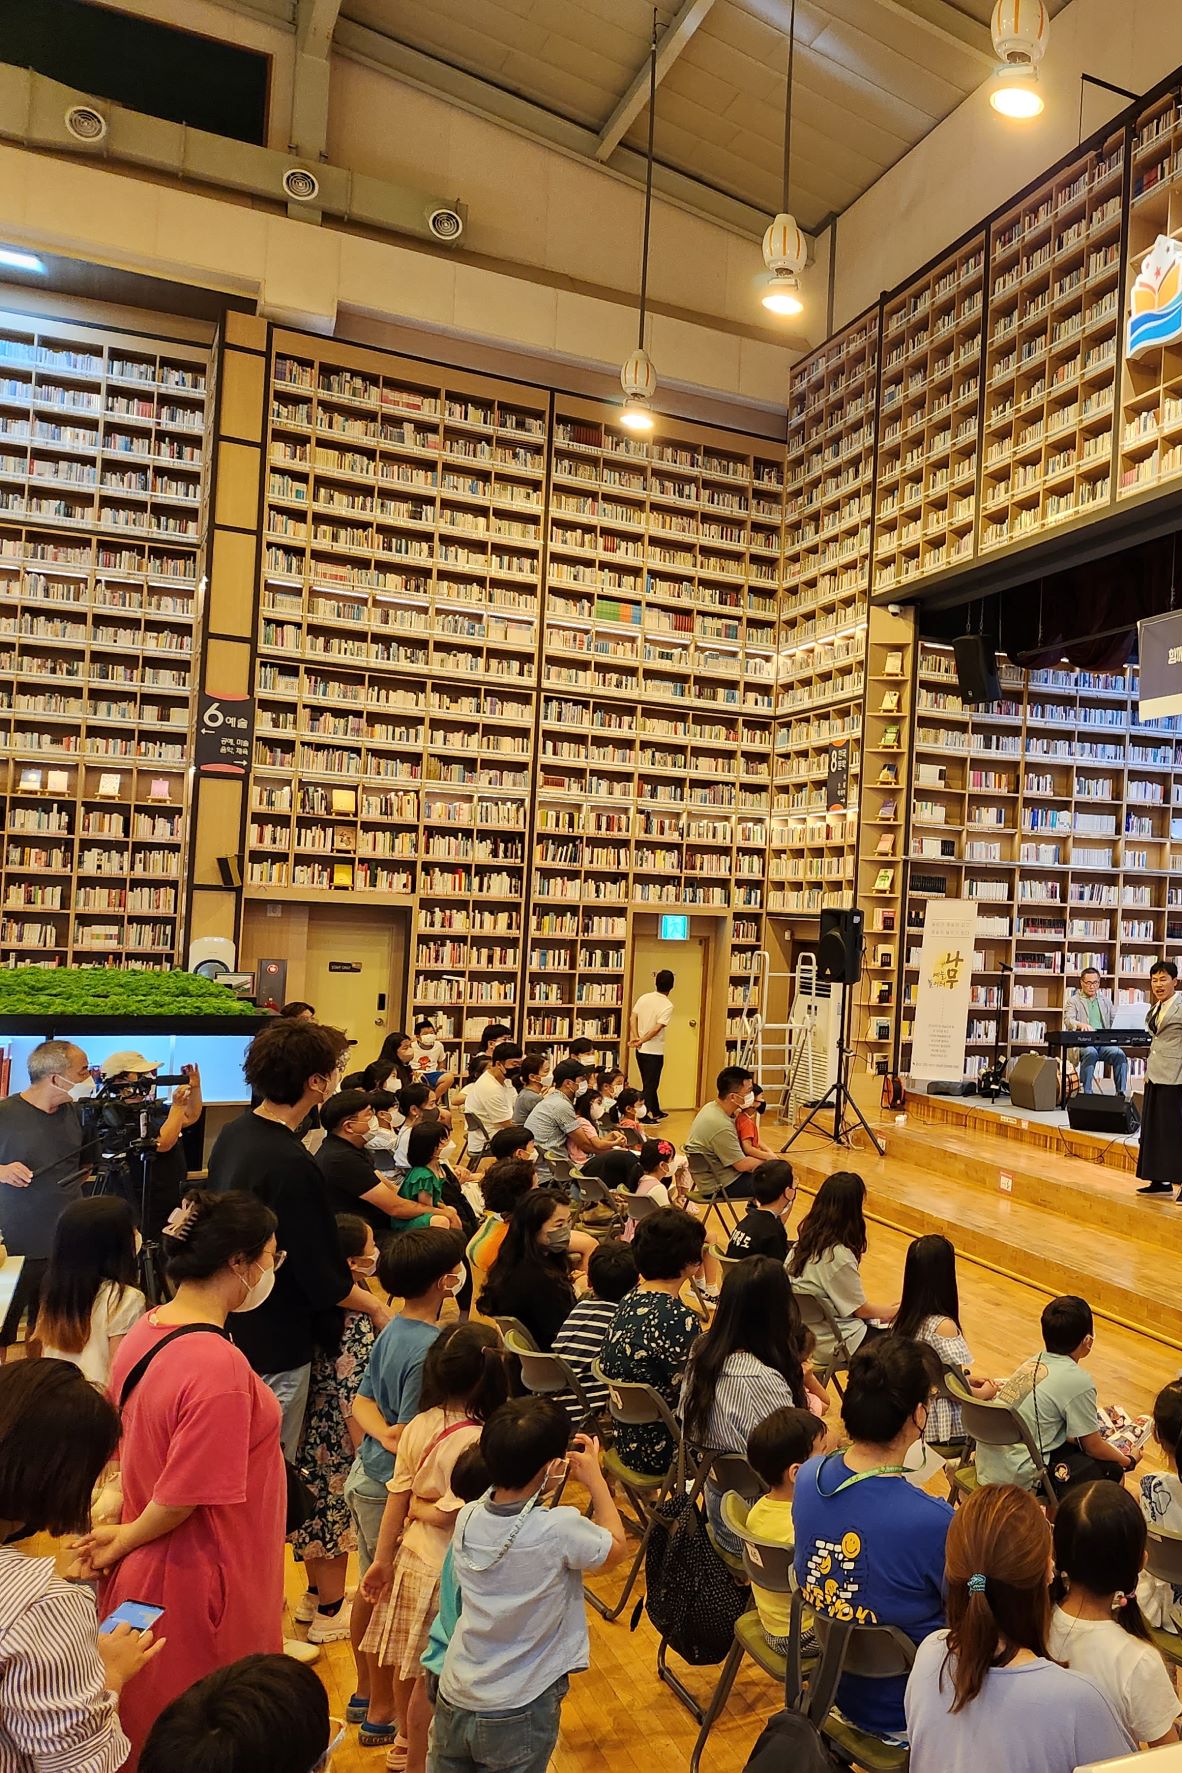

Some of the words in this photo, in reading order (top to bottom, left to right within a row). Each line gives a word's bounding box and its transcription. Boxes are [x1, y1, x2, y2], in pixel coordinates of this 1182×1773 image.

[203, 702, 224, 728] 6
[225, 716, 248, 729] 예술
[830, 749, 837, 773] 8
